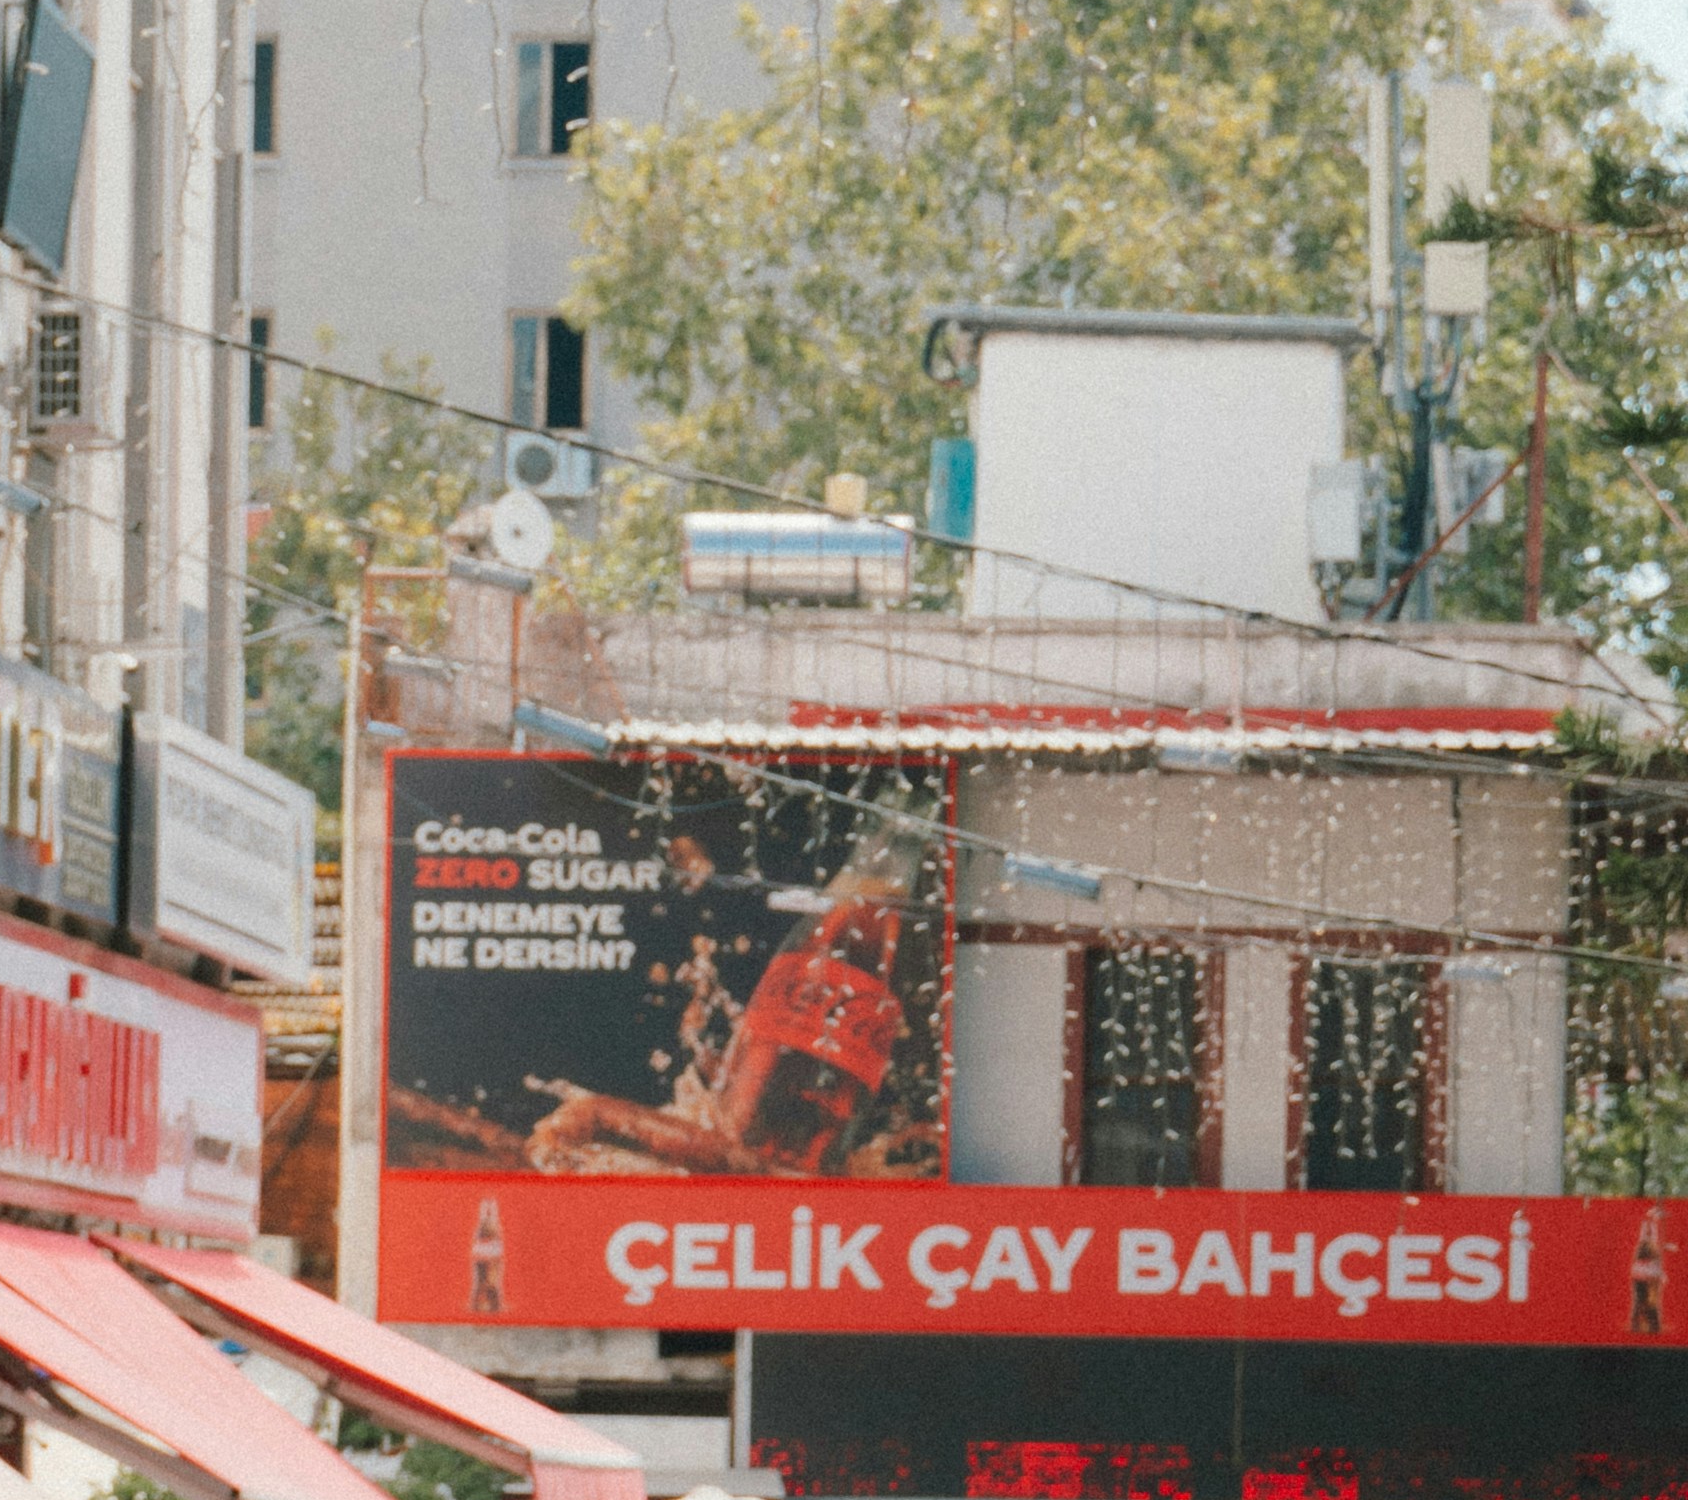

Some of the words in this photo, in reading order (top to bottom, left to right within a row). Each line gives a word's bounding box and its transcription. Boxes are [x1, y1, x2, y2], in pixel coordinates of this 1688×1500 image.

[414, 819, 603, 855] Coca-Cola
[414, 856, 520, 889] ZERO
[527, 857, 664, 891] SUGAR
[413, 900, 625, 934] DENEMEYE
[413, 936, 469, 968] NE
[474, 931, 637, 970] DERSİN?
[605, 1206, 882, 1306] ÇELİK
[908, 1224, 1094, 1309] ÇAY
[1118, 1216, 1532, 1317] BAHÇESİ
